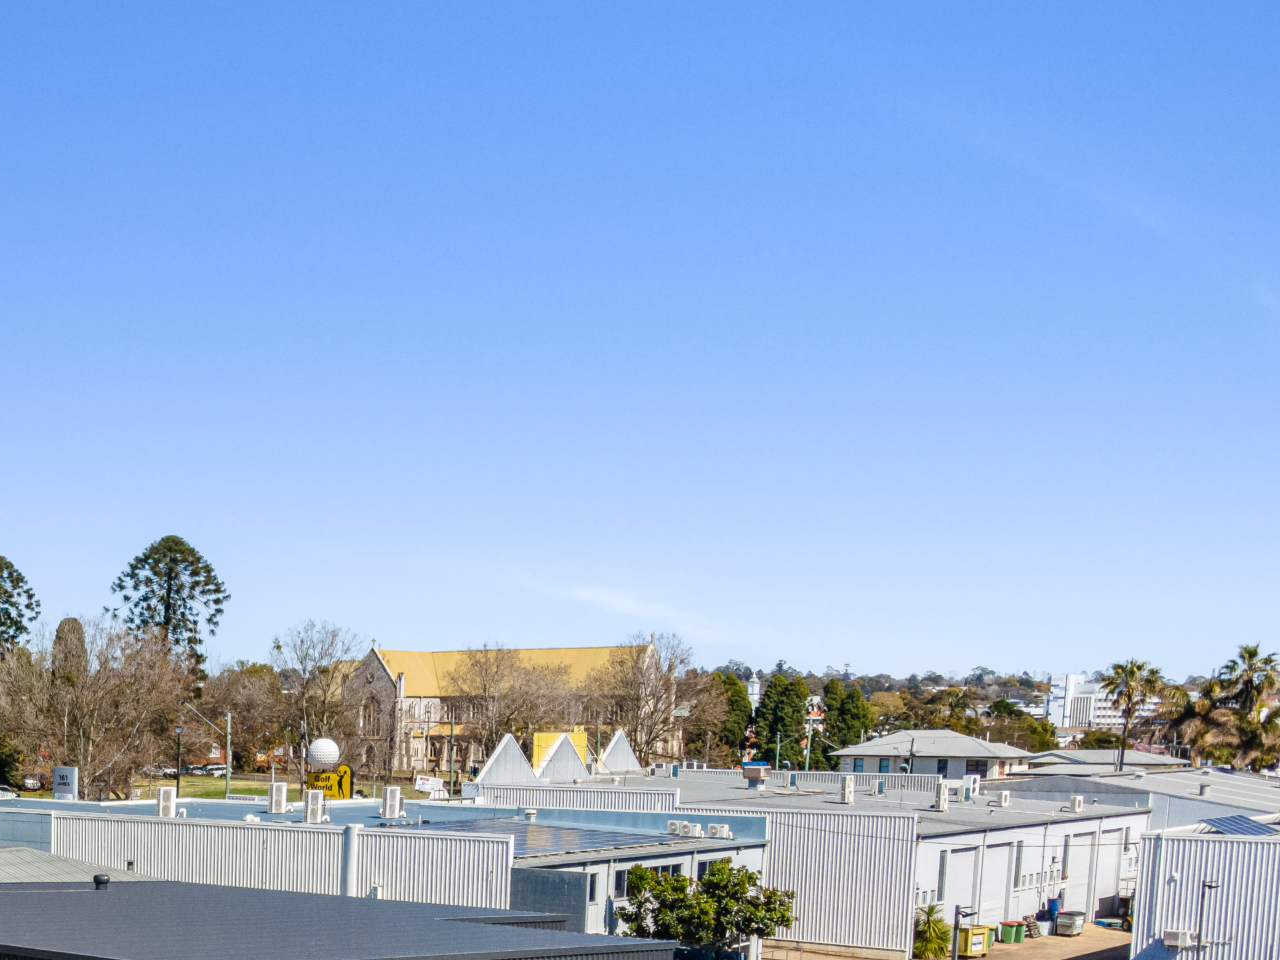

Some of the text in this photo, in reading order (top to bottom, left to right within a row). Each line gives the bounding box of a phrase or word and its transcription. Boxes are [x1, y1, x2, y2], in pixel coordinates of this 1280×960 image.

[58, 774, 68, 782] 161
[314, 774, 331, 783] Golf
[310, 783, 333, 792] World
